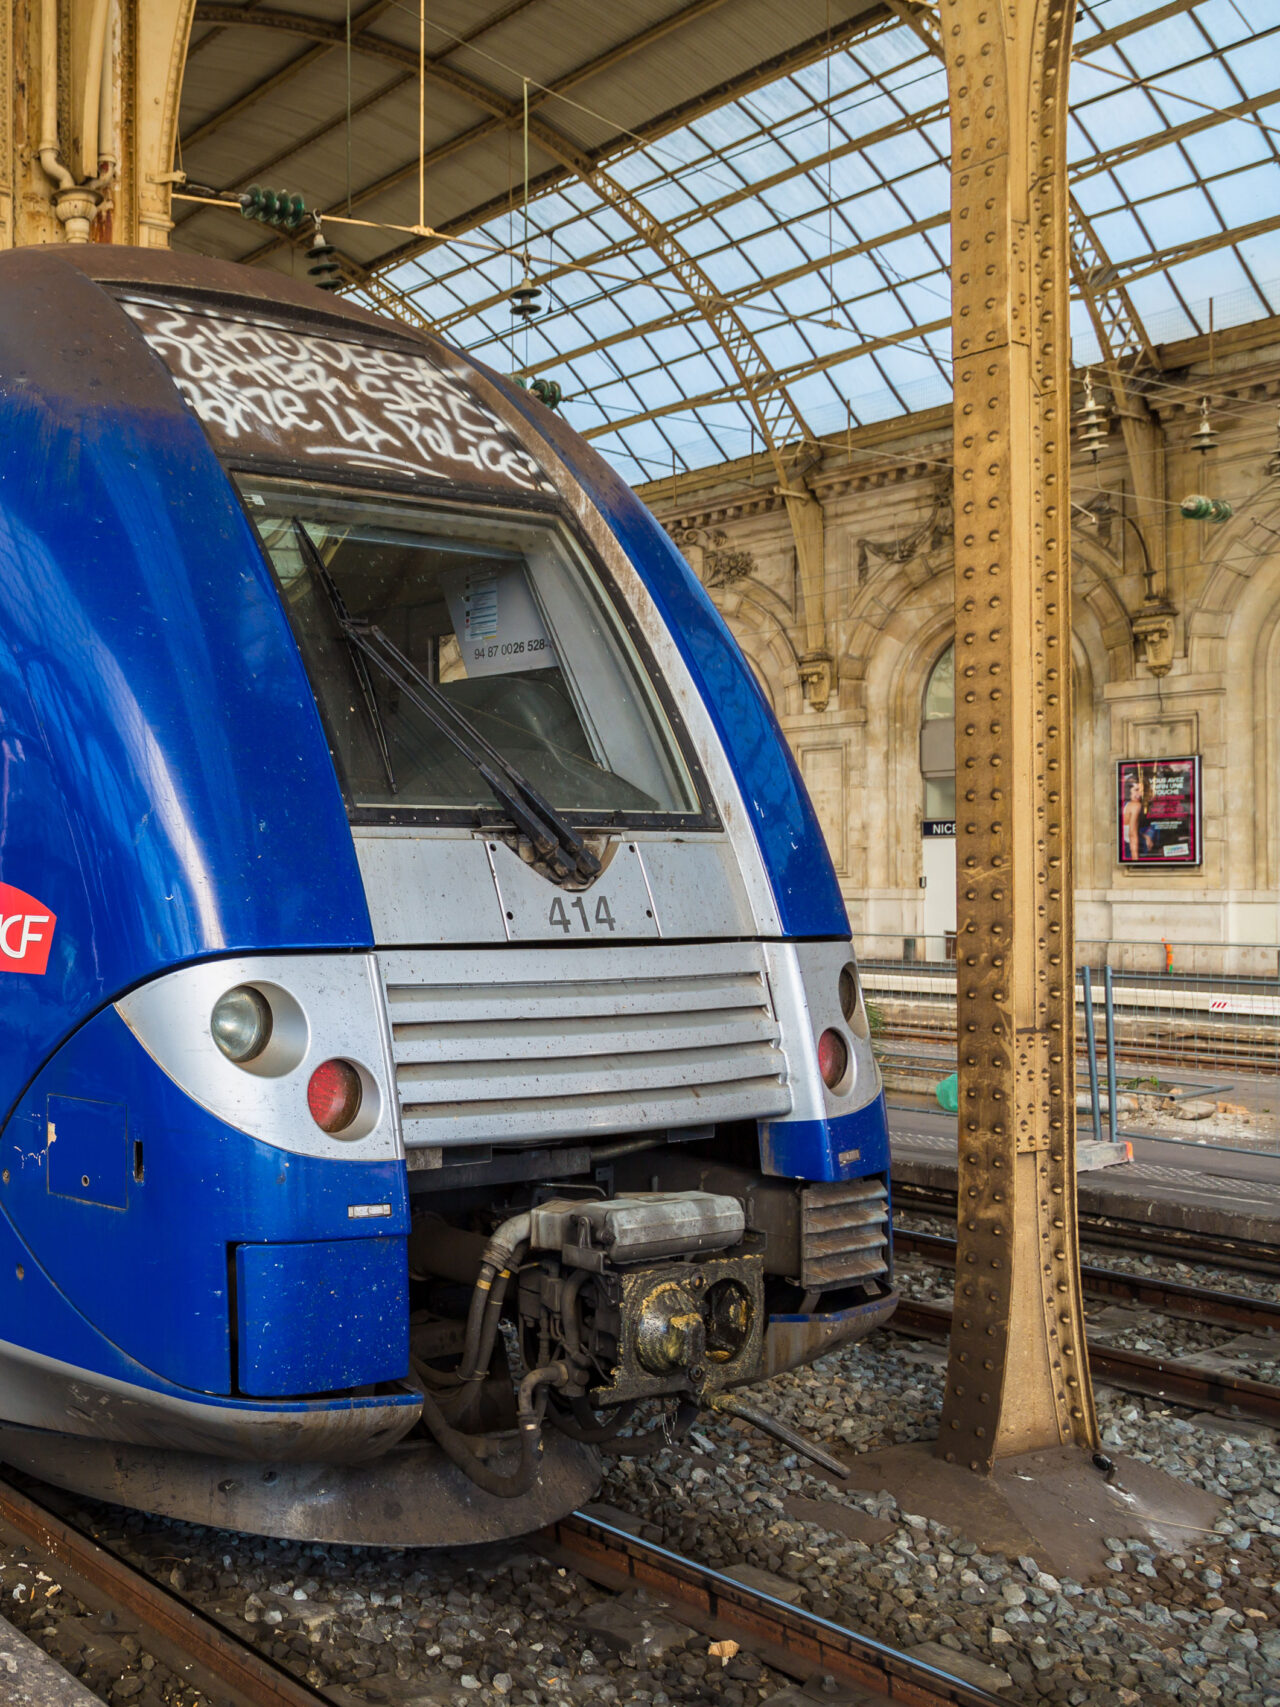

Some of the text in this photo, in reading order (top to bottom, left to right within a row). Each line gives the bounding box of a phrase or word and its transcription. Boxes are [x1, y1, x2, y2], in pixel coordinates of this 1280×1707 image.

[316, 398, 404, 453] LA
[474, 648, 485, 660] 94
[487, 645, 499, 658] 87
[501, 642, 525, 656] 0026
[549, 895, 616, 933] 414
